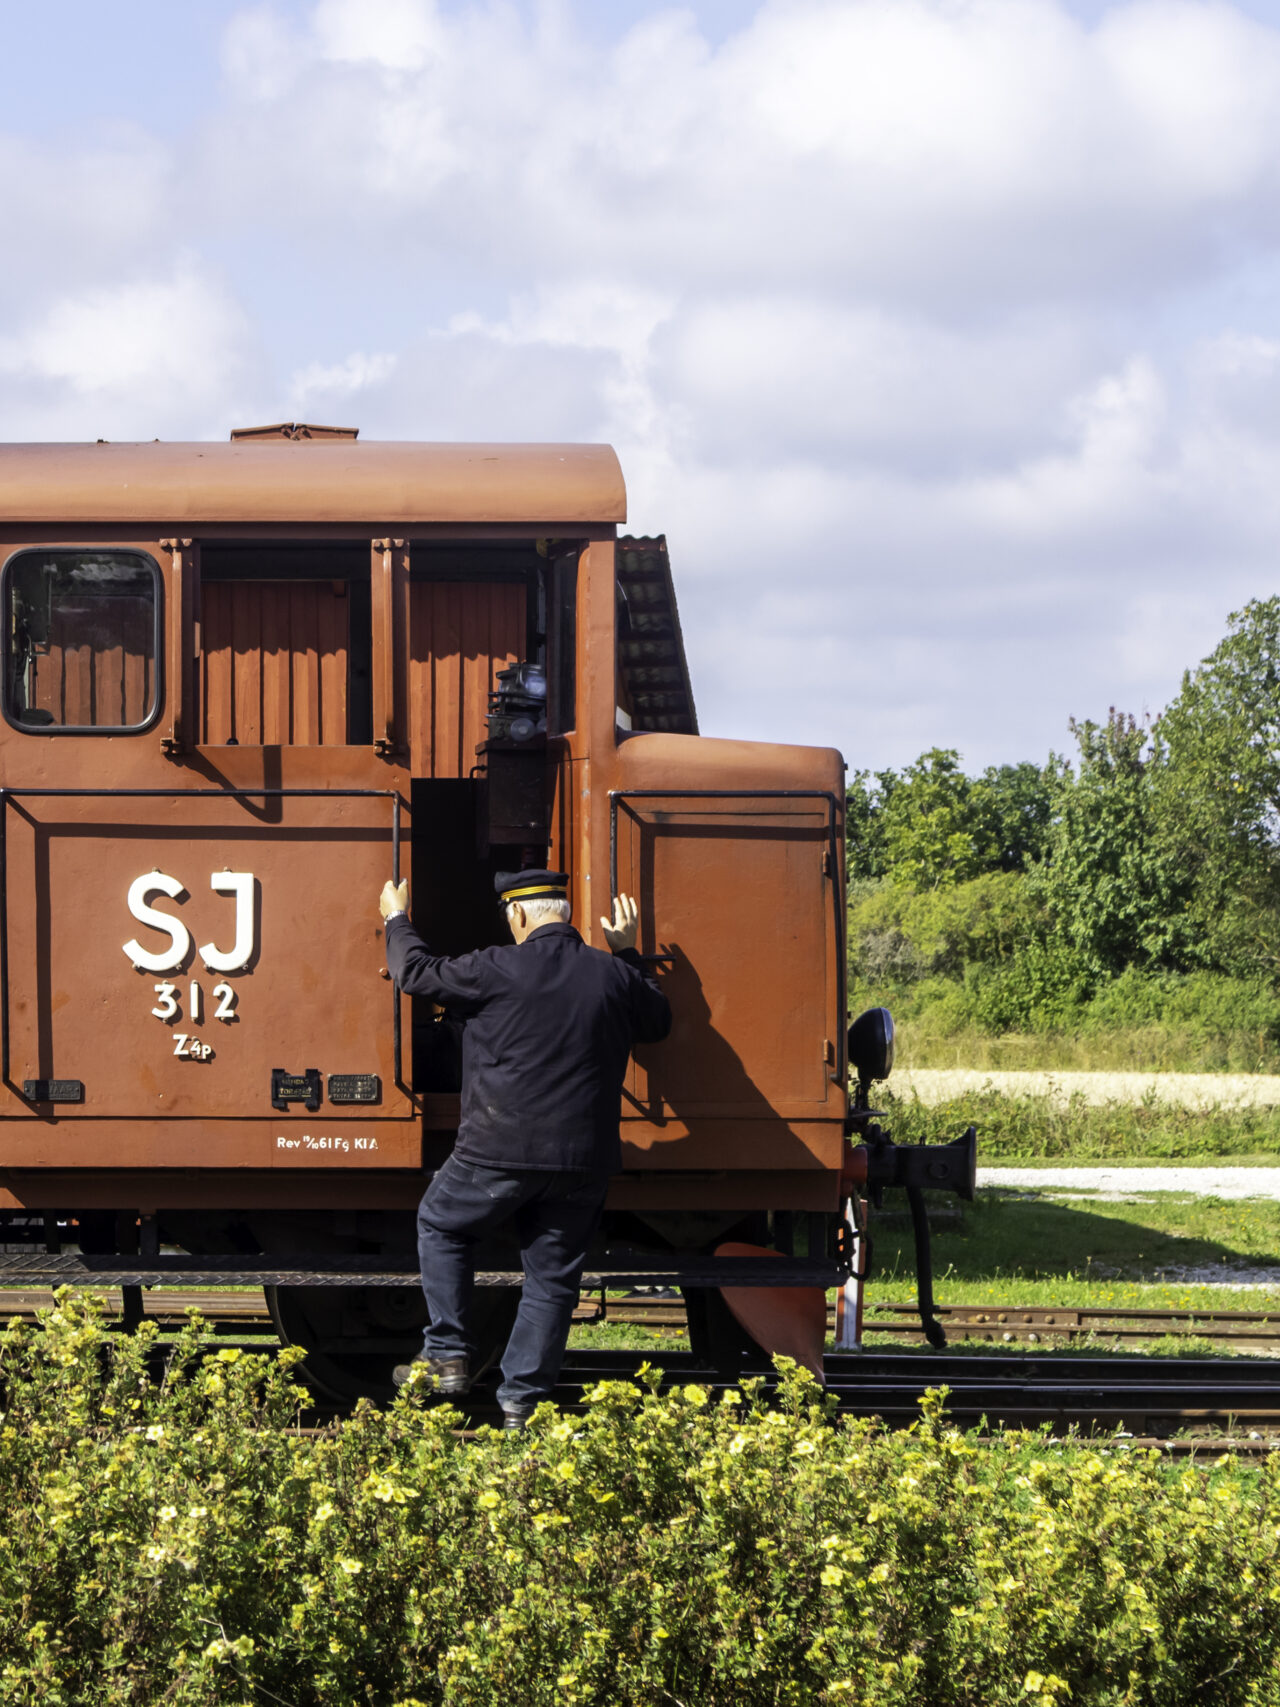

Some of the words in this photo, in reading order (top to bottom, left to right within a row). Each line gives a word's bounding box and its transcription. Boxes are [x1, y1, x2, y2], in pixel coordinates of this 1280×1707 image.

[122, 871, 254, 971] SJ
[151, 983, 235, 1019] 312
[276, 1137, 301, 1149] Rev
